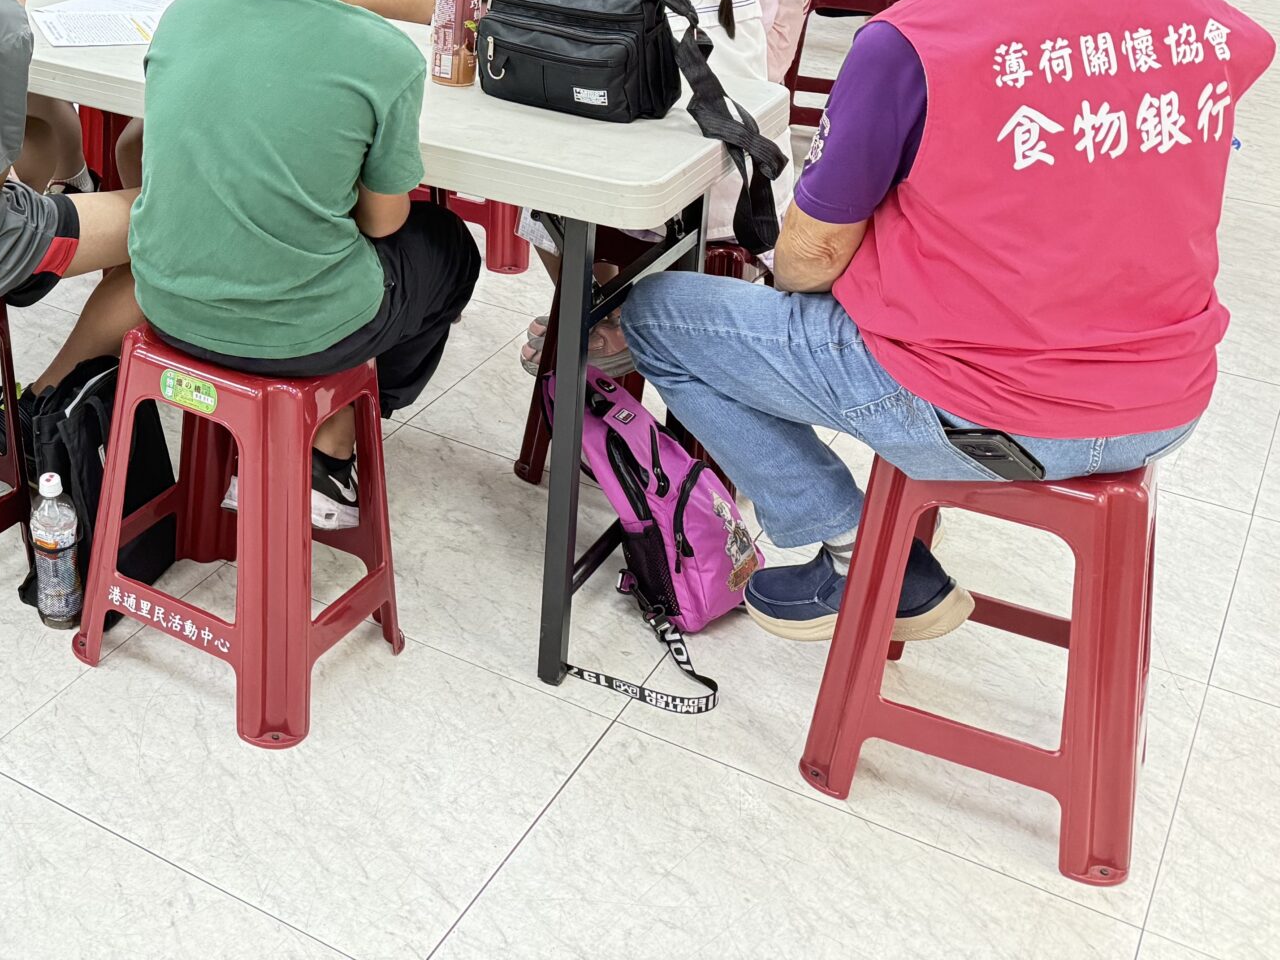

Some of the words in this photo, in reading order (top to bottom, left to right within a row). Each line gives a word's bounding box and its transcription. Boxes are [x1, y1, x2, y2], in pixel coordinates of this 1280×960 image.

[992, 18, 1231, 88] 薄荷關懷協會
[997, 80, 1231, 171] 食物銀行
[108, 585, 230, 653] 港通里民活動中心
